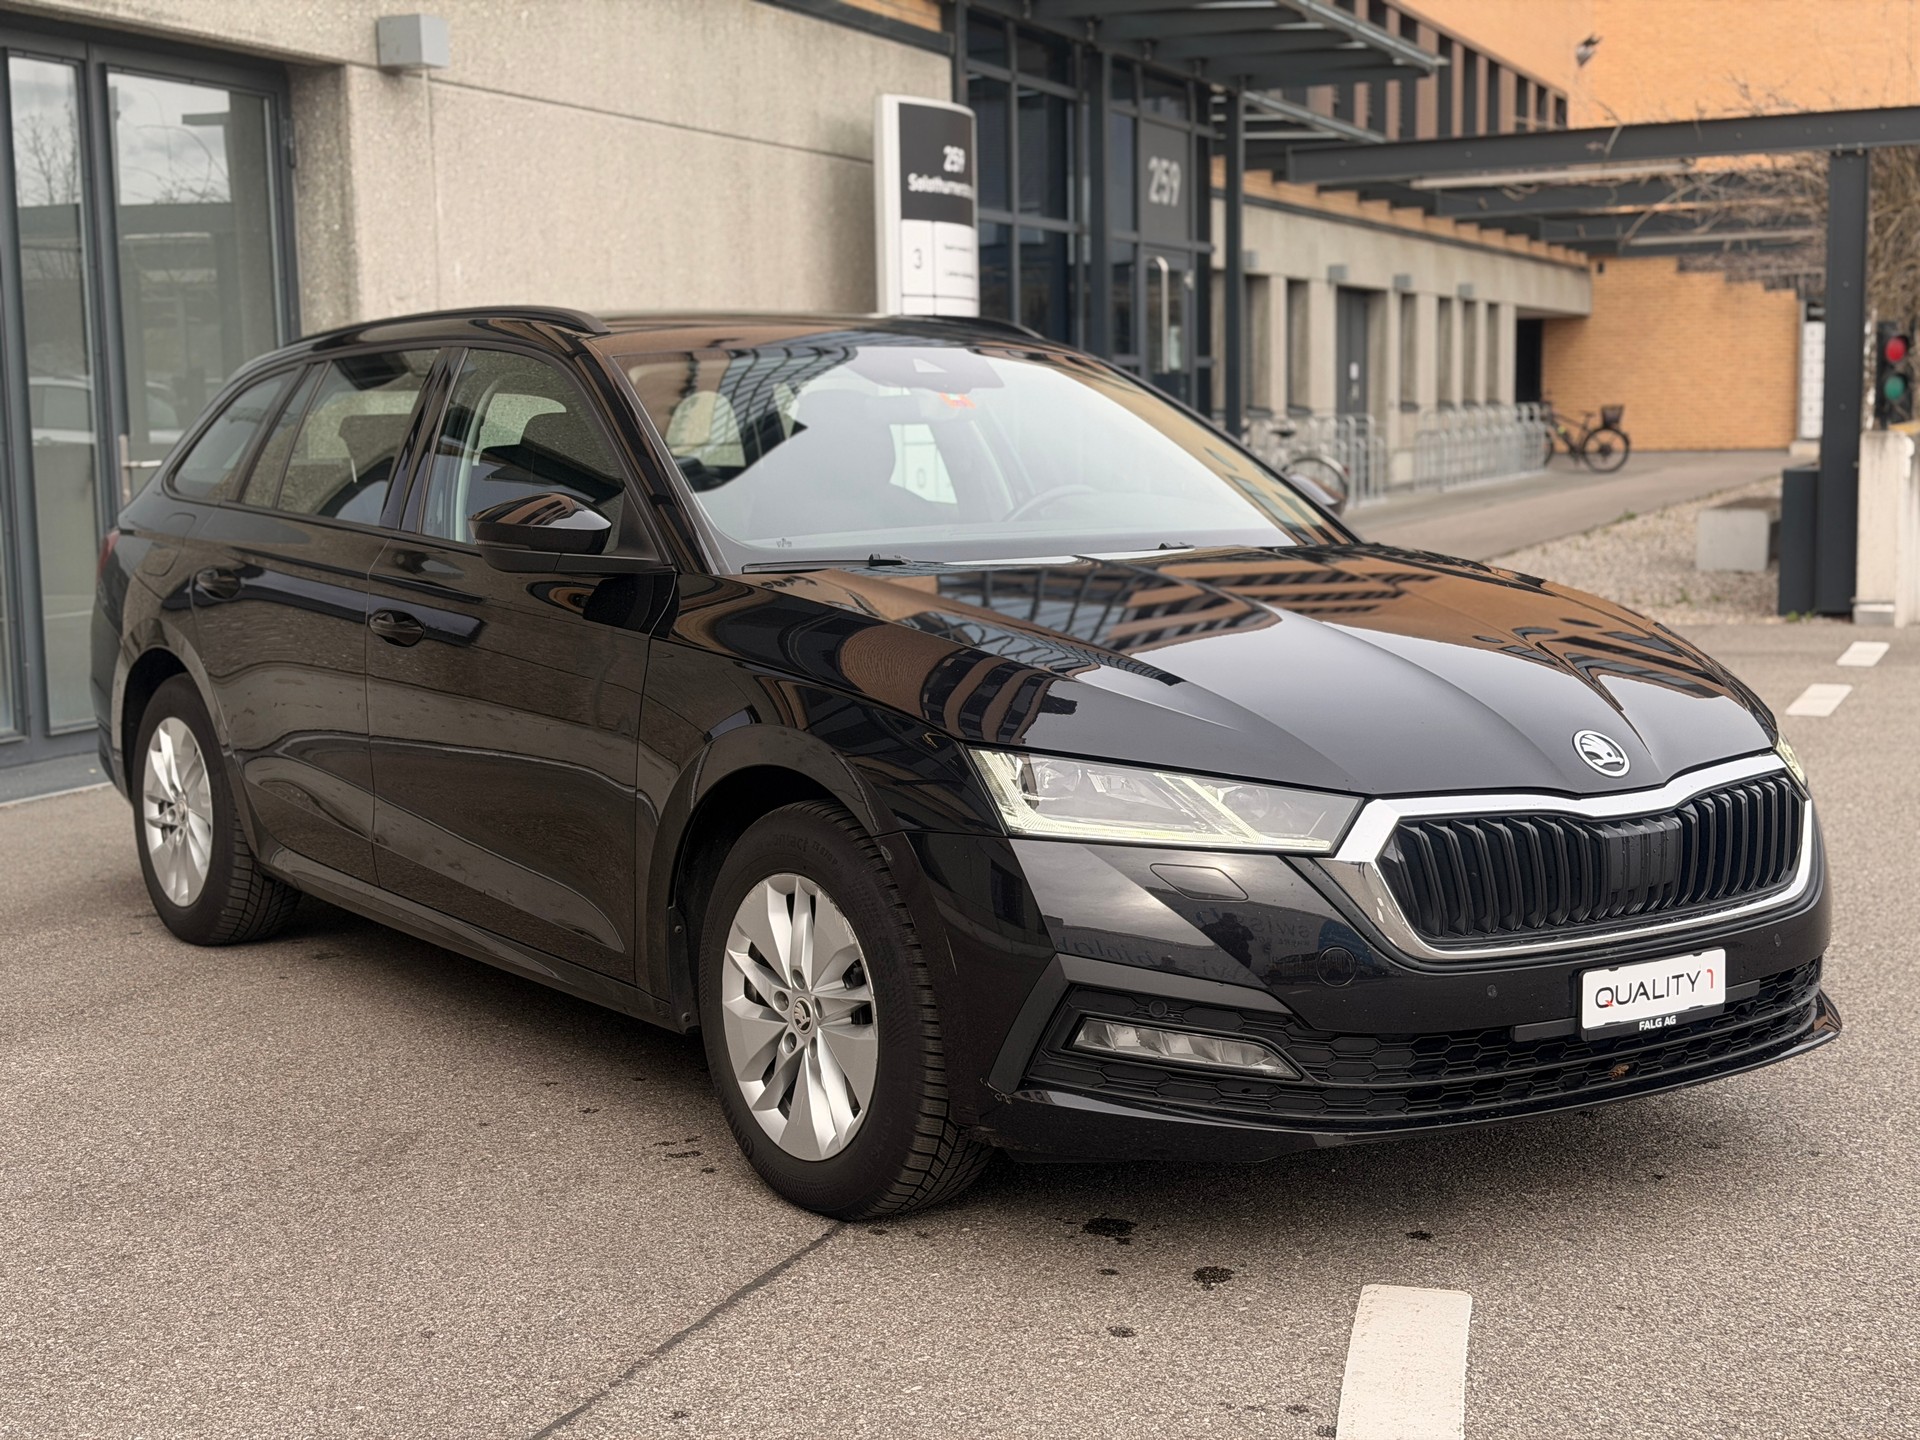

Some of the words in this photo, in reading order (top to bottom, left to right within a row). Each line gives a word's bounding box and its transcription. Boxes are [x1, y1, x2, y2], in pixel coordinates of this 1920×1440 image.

[1149, 156, 1181, 207] 259
[1595, 970, 1701, 1009] QUALITY
[1706, 968, 1714, 989] 1
[1639, 1018, 1663, 1031] FALG
[1664, 1015, 1677, 1026] AG
